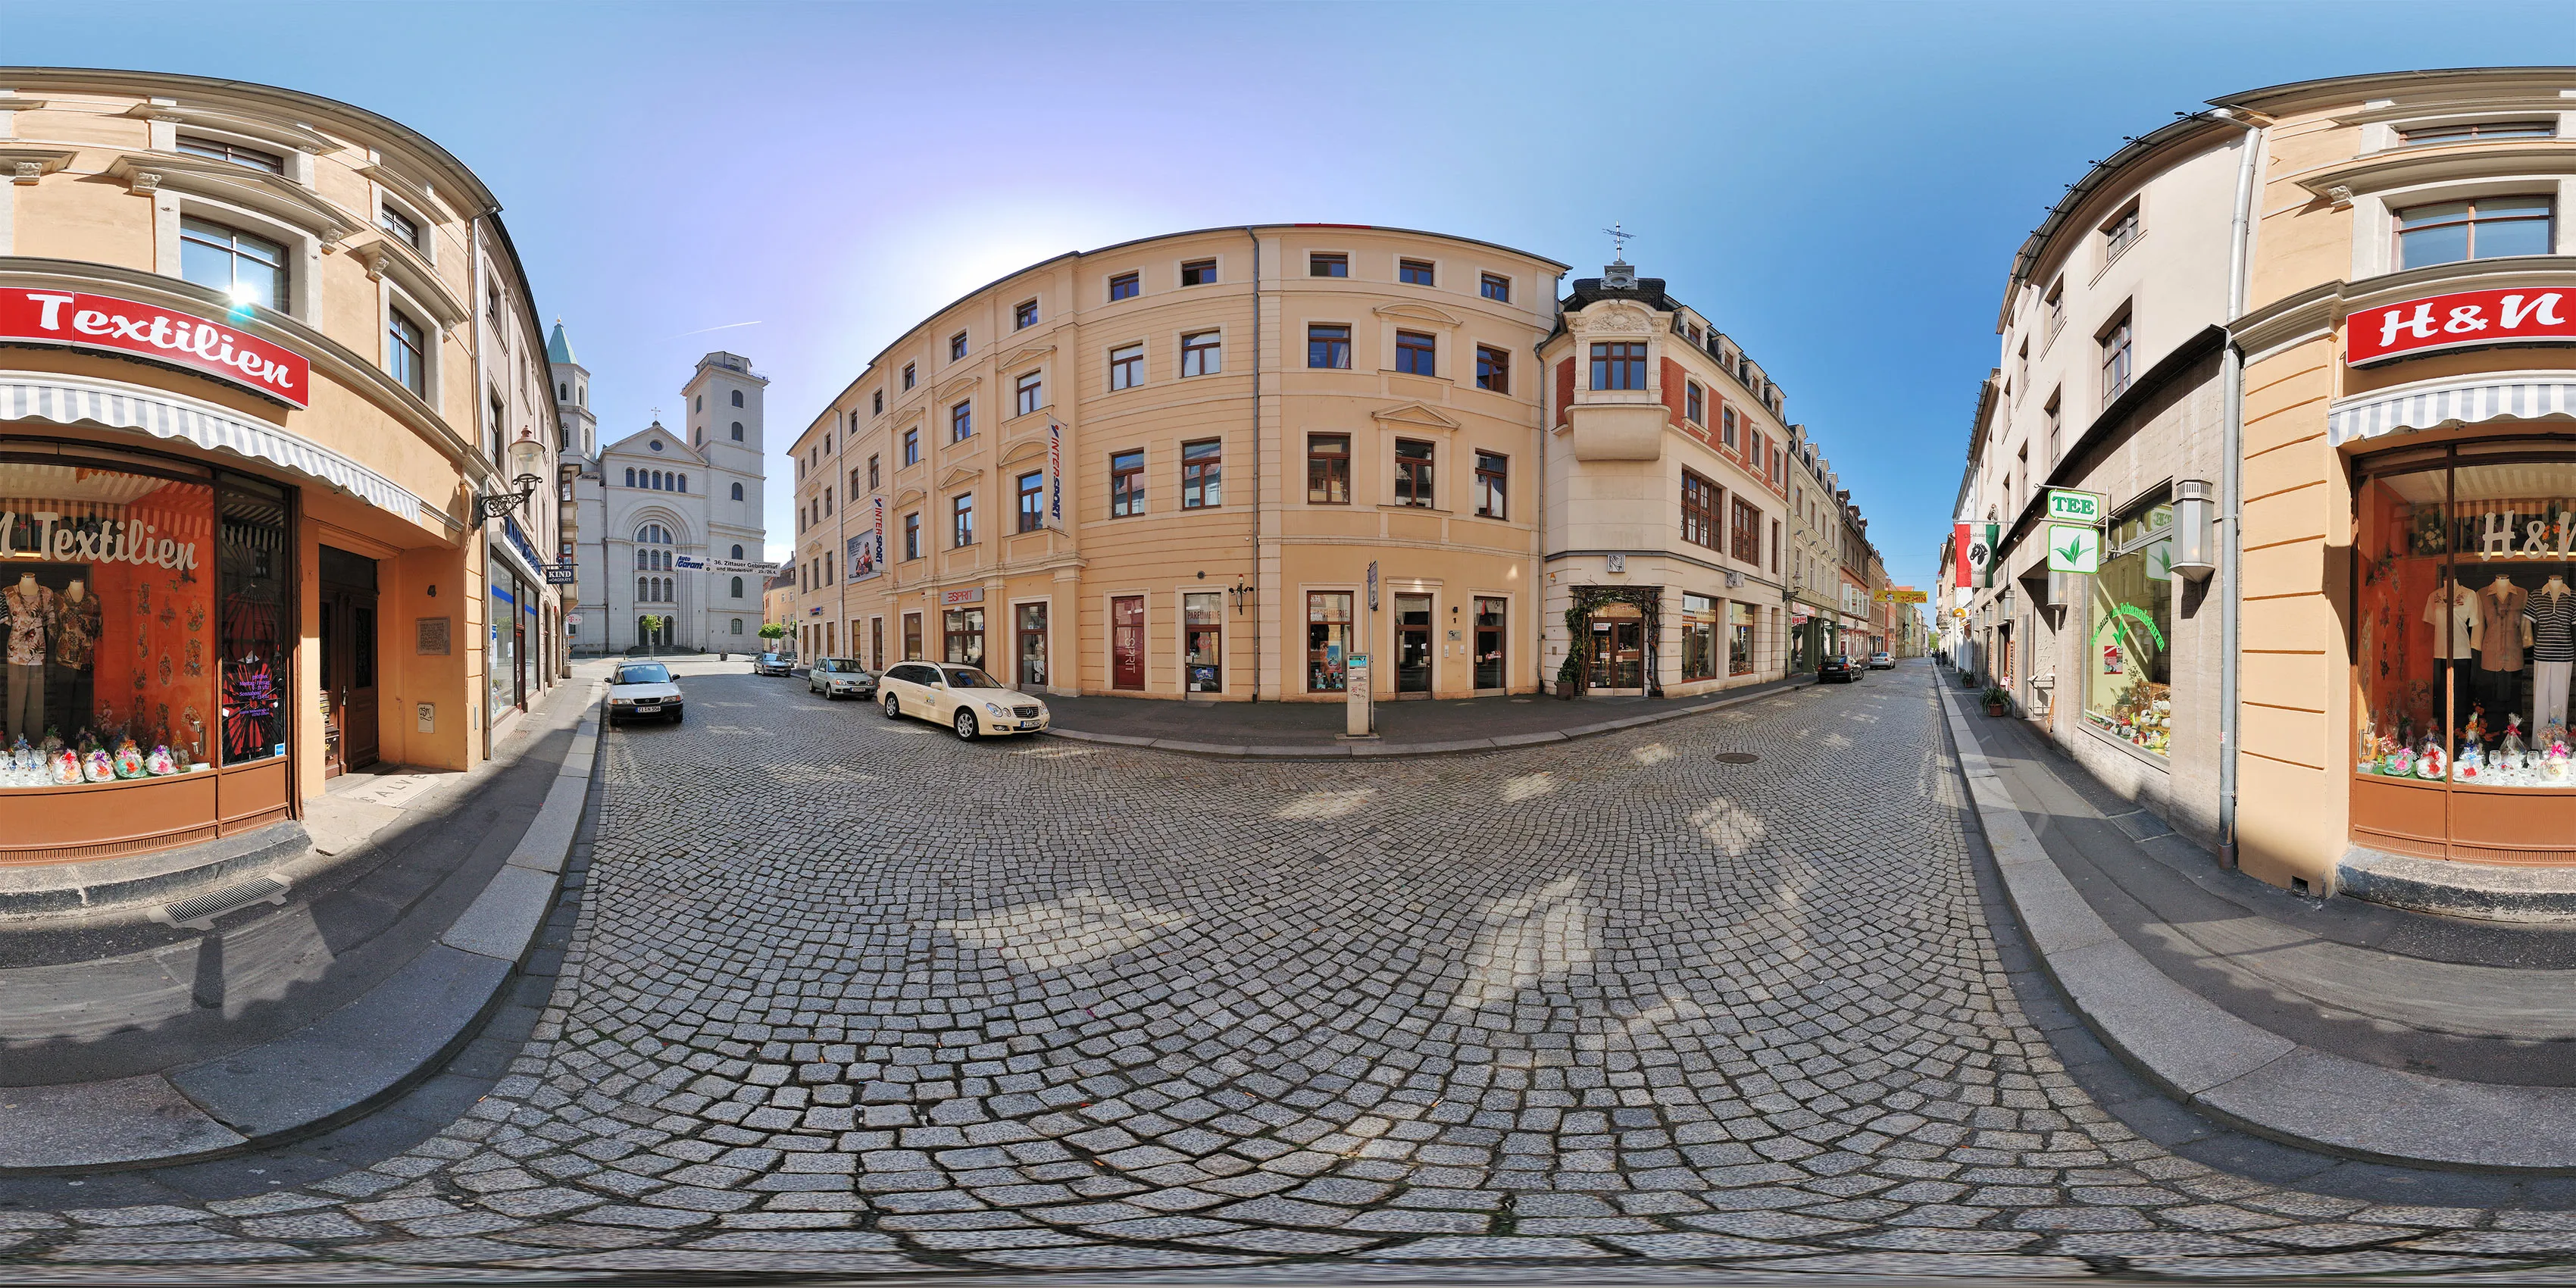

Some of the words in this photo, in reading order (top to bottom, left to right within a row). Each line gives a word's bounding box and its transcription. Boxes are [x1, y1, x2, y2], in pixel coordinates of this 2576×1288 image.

[27, 293, 294, 388] Textilien
[1051, 437, 1061, 521] INTERSPORT
[2052, 496, 2095, 515] TEE
[33, 511, 199, 571] Textilien
[874, 508, 883, 564] INTERSPORT
[677, 561, 704, 570] Garant
[427, 585, 436, 597] 4
[948, 590, 973, 602] ESPRIT
[1187, 609, 1221, 620] PARFÜMERIE
[2118, 602, 2165, 652] Johannisturm
[1124, 630, 1135, 674] ESPRIT
[358, 773, 428, 804] SALVE
